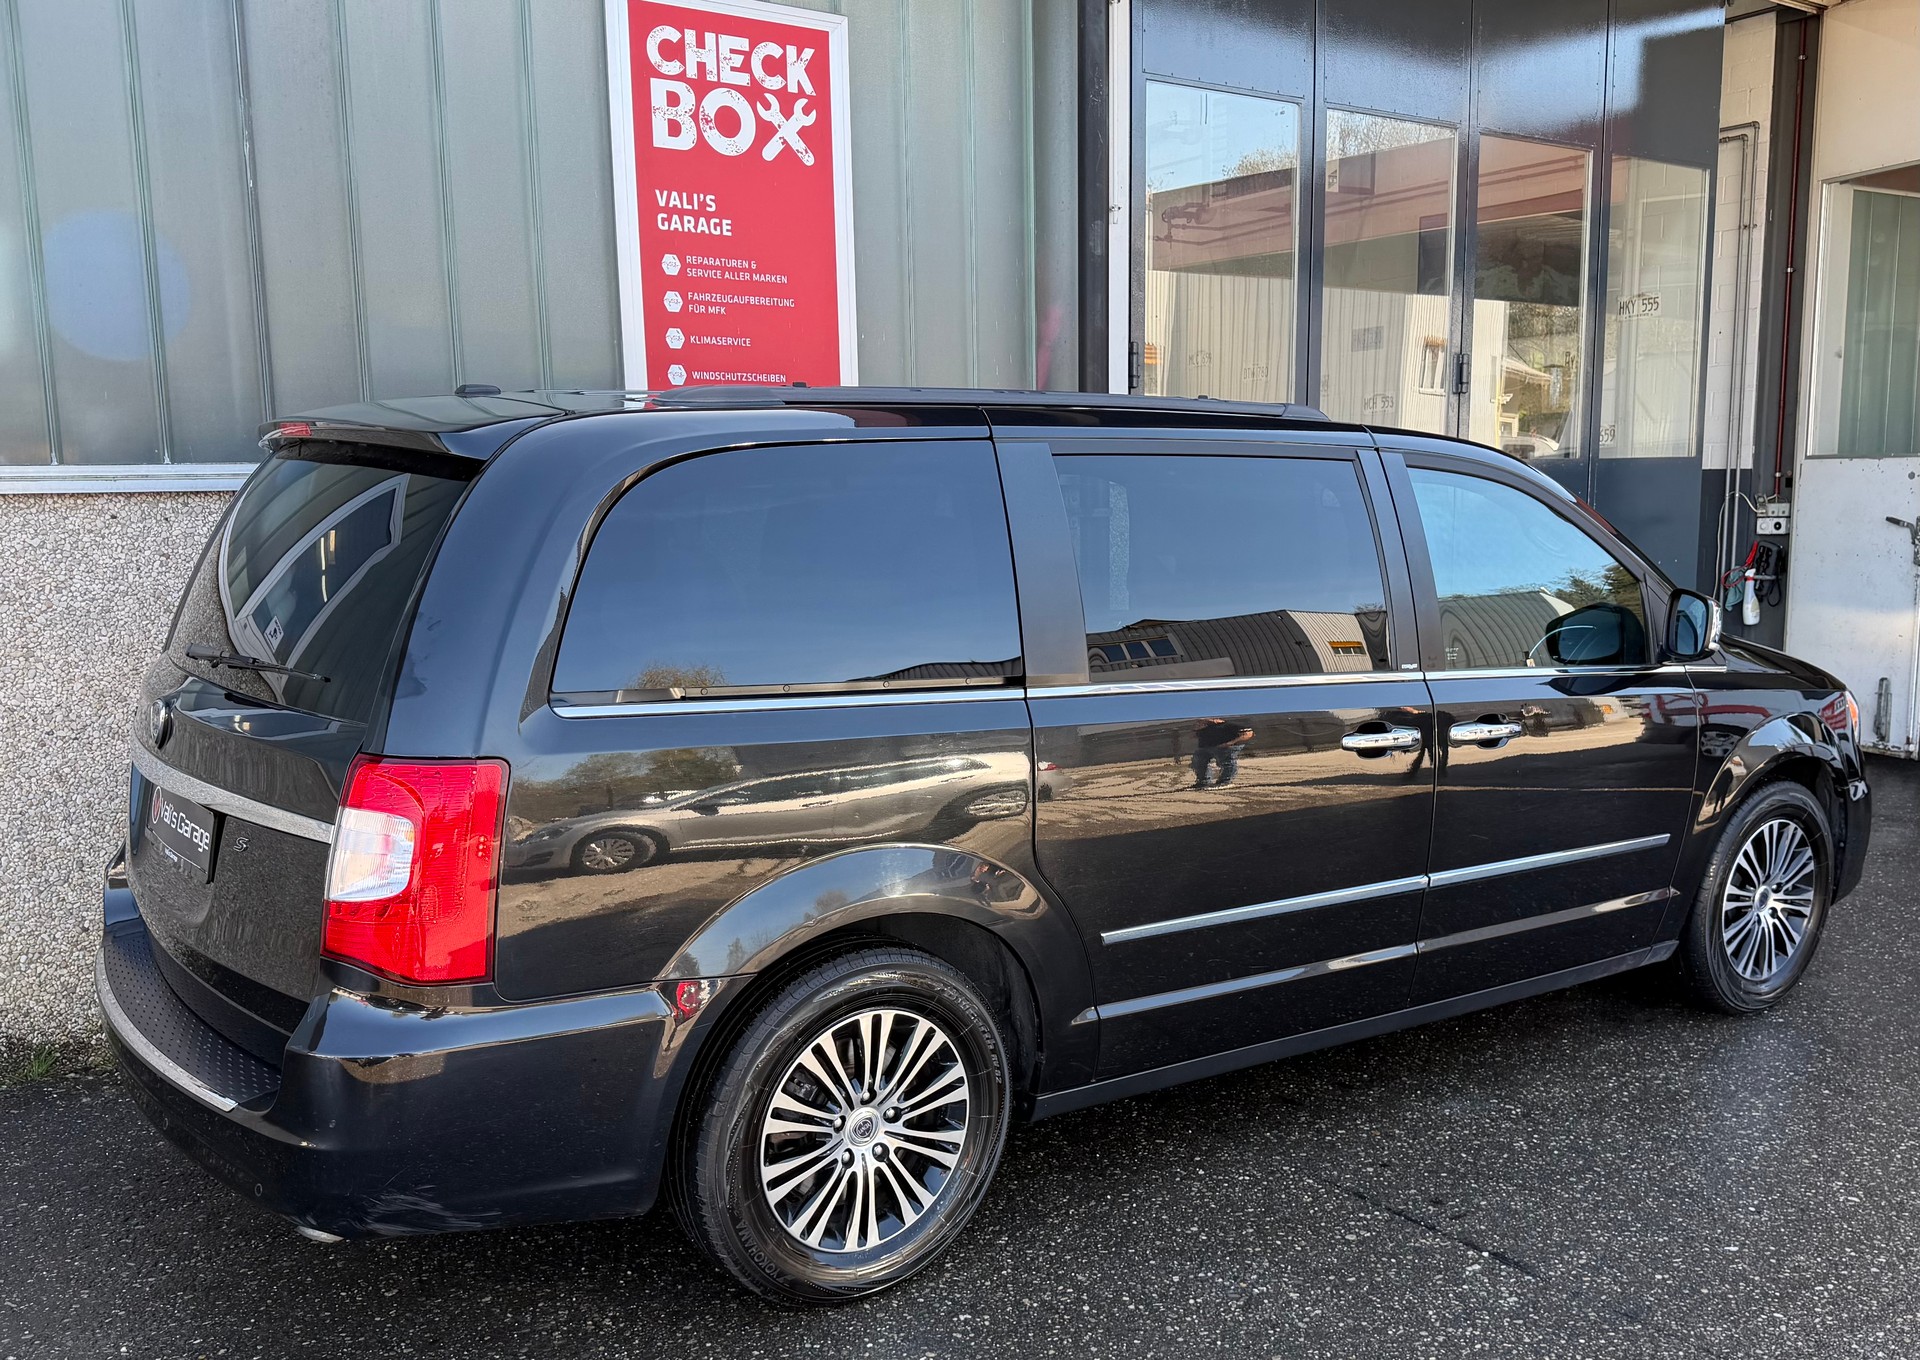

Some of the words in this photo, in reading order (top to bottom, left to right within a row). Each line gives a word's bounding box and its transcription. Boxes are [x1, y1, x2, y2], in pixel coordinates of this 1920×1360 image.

[647, 25, 816, 96] CHECK
[655, 189, 716, 212] VALI'S
[657, 213, 732, 236] GARAGE
[686, 255, 749, 269] REPARATUREN
[751, 260, 757, 269] &
[686, 268, 722, 279] SERVICE
[724, 270, 750, 281] ALLER
[752, 273, 788, 284] MARKEN
[687, 292, 795, 308] FAHRZEUGAUFBEREITUNG
[688, 303, 706, 314] FÜR
[708, 306, 726, 315] MFK
[1619, 299, 1637, 316] HKY
[1641, 296, 1660, 313] 555
[690, 335, 751, 347] KLIMASERVICE
[692, 370, 787, 383] WINDSCHUTZSCHEIBEN
[177, 812, 210, 853] Garage
[735, 1219, 781, 1279] YOKOHAMA
